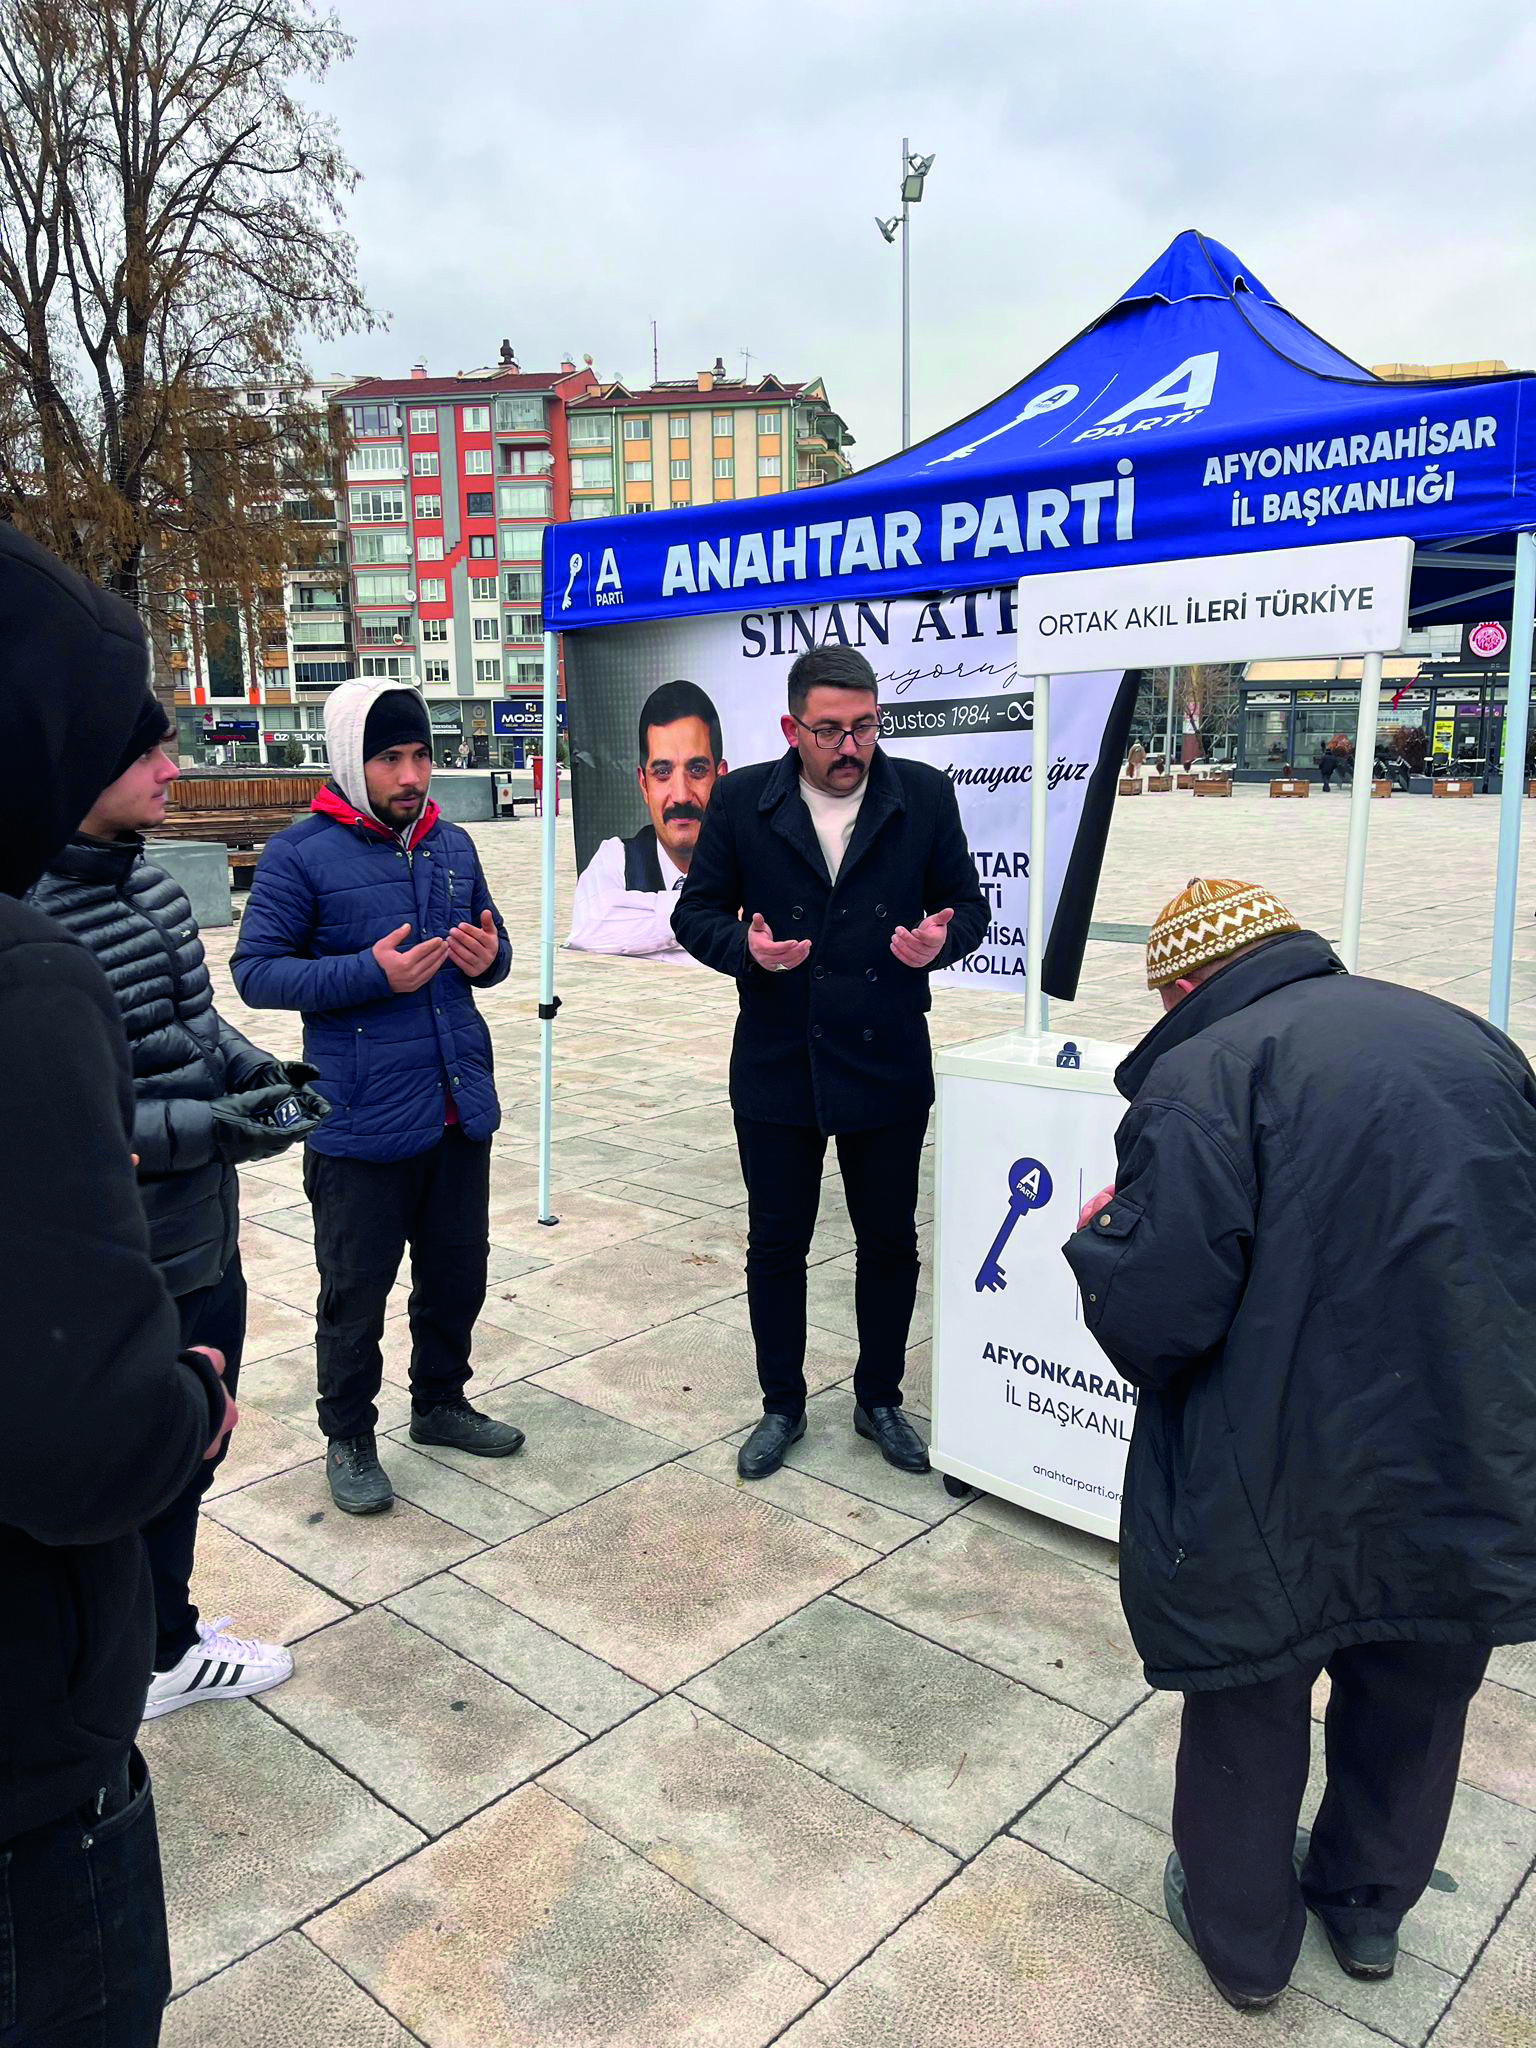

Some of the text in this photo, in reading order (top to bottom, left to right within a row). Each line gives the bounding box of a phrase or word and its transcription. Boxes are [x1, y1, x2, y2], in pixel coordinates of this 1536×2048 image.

[1094, 351, 1219, 426] A
[1203, 416, 1498, 487] AFYONKARAHİSAR
[1231, 464, 1455, 527] İL BAŞKANLIĞI
[662, 458, 1136, 597] ANAHTAR PARTİ
[595, 547, 622, 592] A
[911, 585, 1018, 643] ATE
[1038, 584, 1375, 637] ORTAK AKIL İLERİ TÜRKİYE
[501, 713, 563, 726] MODEN
[881, 710, 946, 736] ğustos
[951, 703, 991, 727] 1984
[961, 954, 1027, 977] KOLLA
[1019, 1167, 1041, 1195] A
[981, 1341, 1139, 1407] AFYONKARAH
[1006, 1379, 1131, 1443] İL BAŞKANL
[1032, 1464, 1124, 1505] anahtarparti.or
